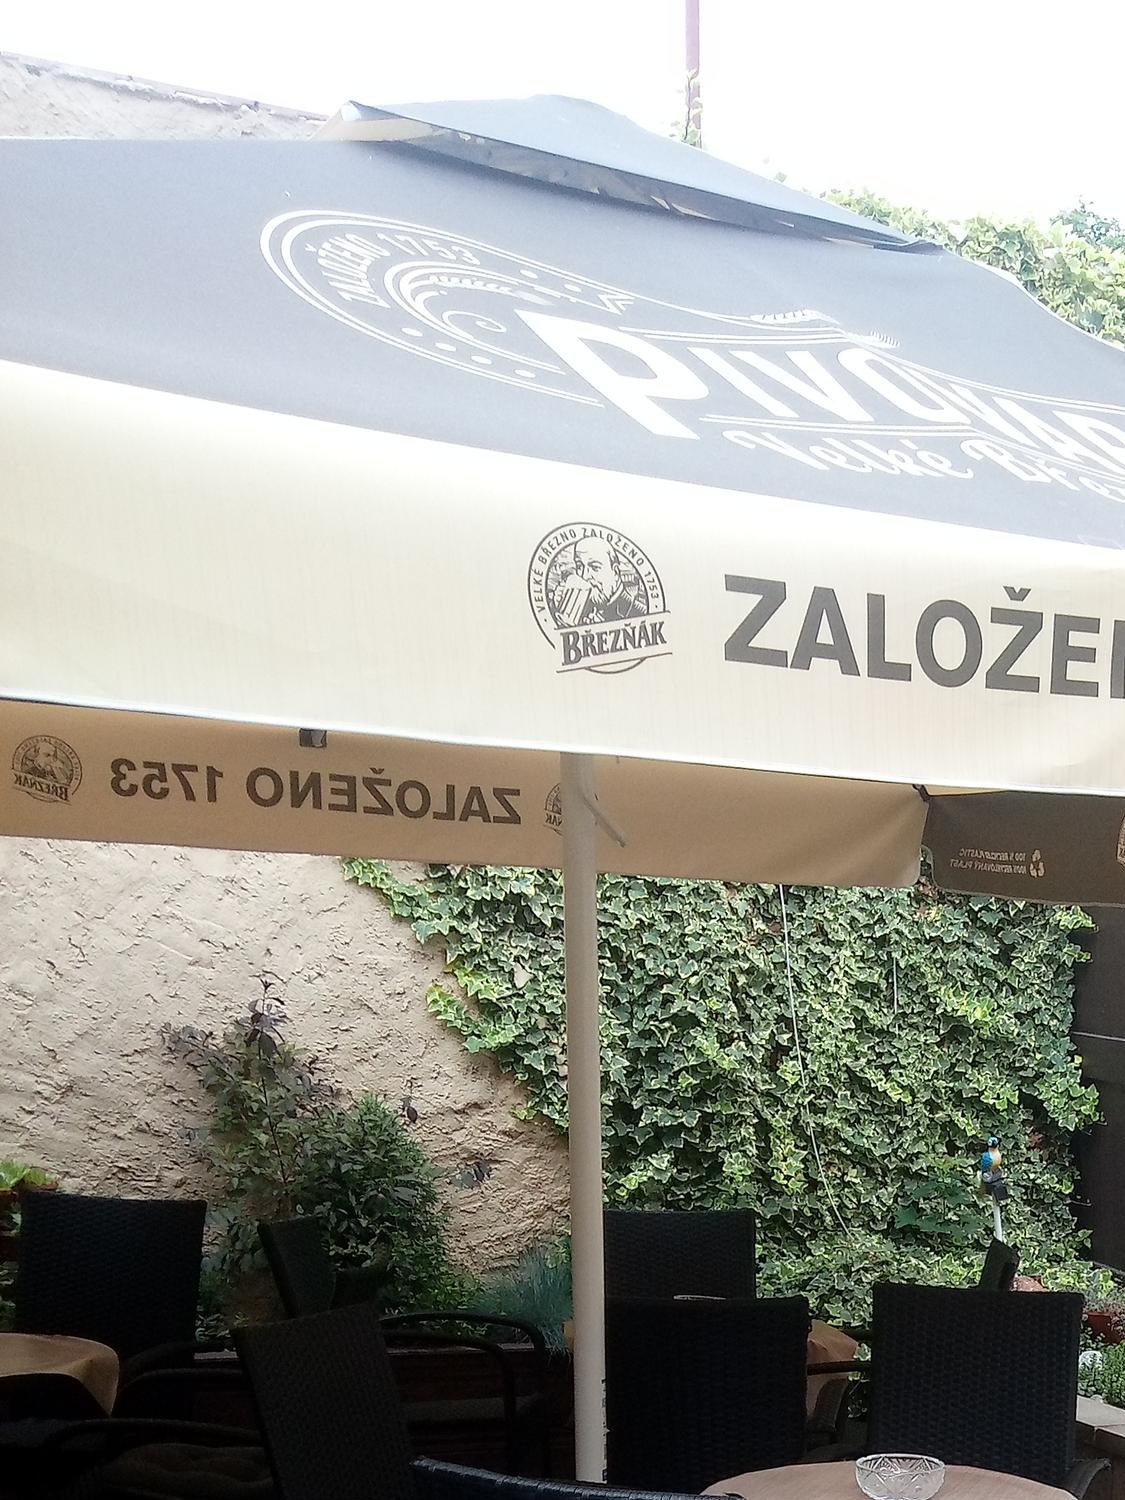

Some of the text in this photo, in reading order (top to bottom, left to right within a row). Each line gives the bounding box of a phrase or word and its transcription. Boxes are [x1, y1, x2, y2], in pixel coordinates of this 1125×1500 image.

[304, 231, 481, 309] ZALOŽENO 1753
[722, 429, 974, 479] Velké
[531, 527, 660, 613] VELKÉ BŘEZNO ZALOŽENO 1753
[559, 620, 668, 667] BŘEZŇÁK
